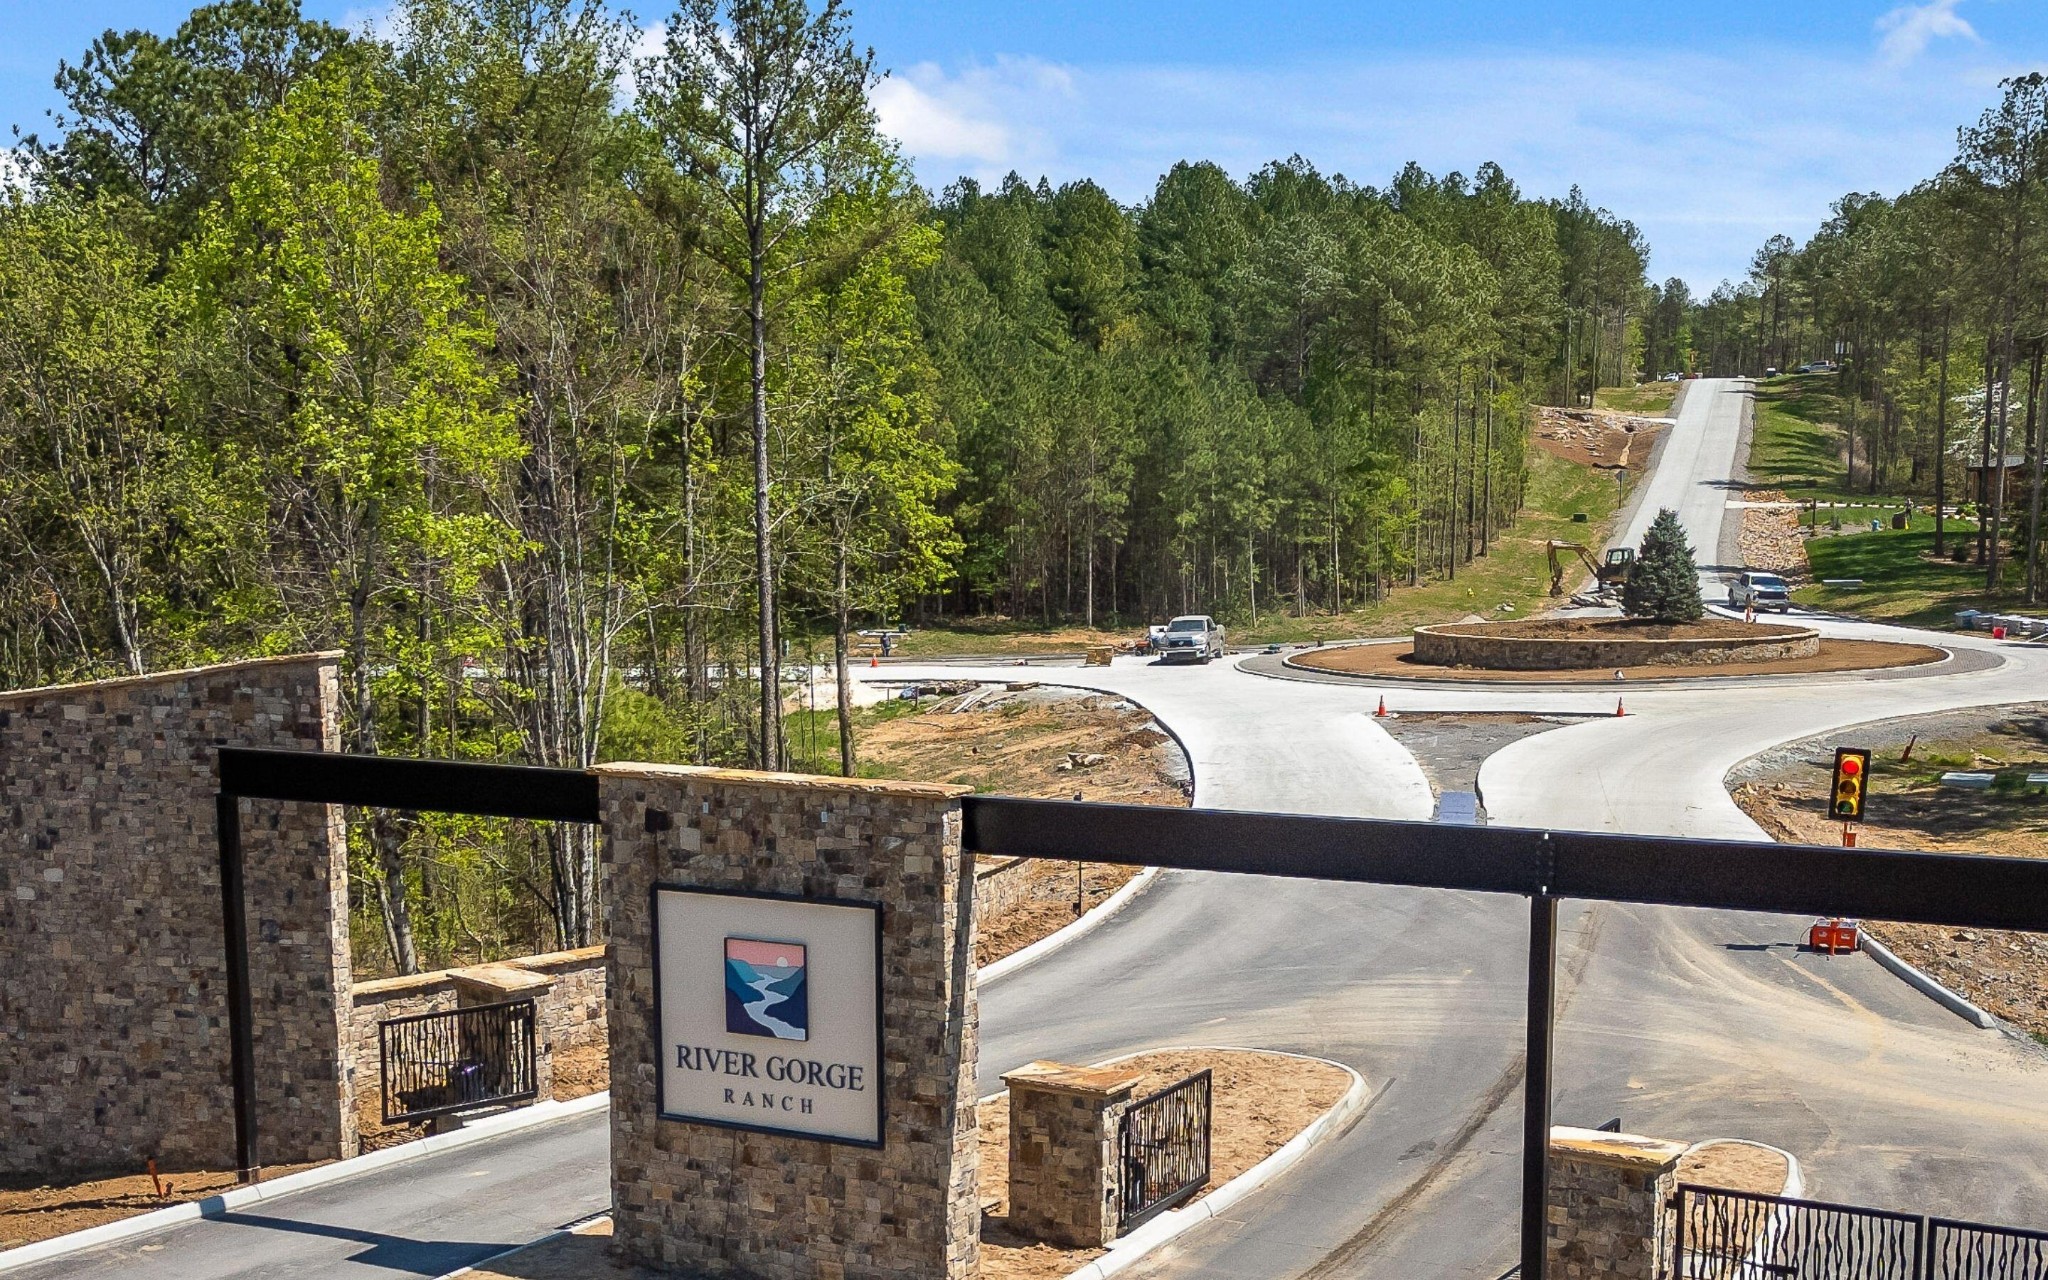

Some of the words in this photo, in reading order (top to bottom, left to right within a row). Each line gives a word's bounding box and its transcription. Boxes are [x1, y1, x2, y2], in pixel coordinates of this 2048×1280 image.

[676, 1044, 759, 1078] RIVER
[766, 1056, 864, 1091] GORGE
[723, 1088, 813, 1114] RANCH
